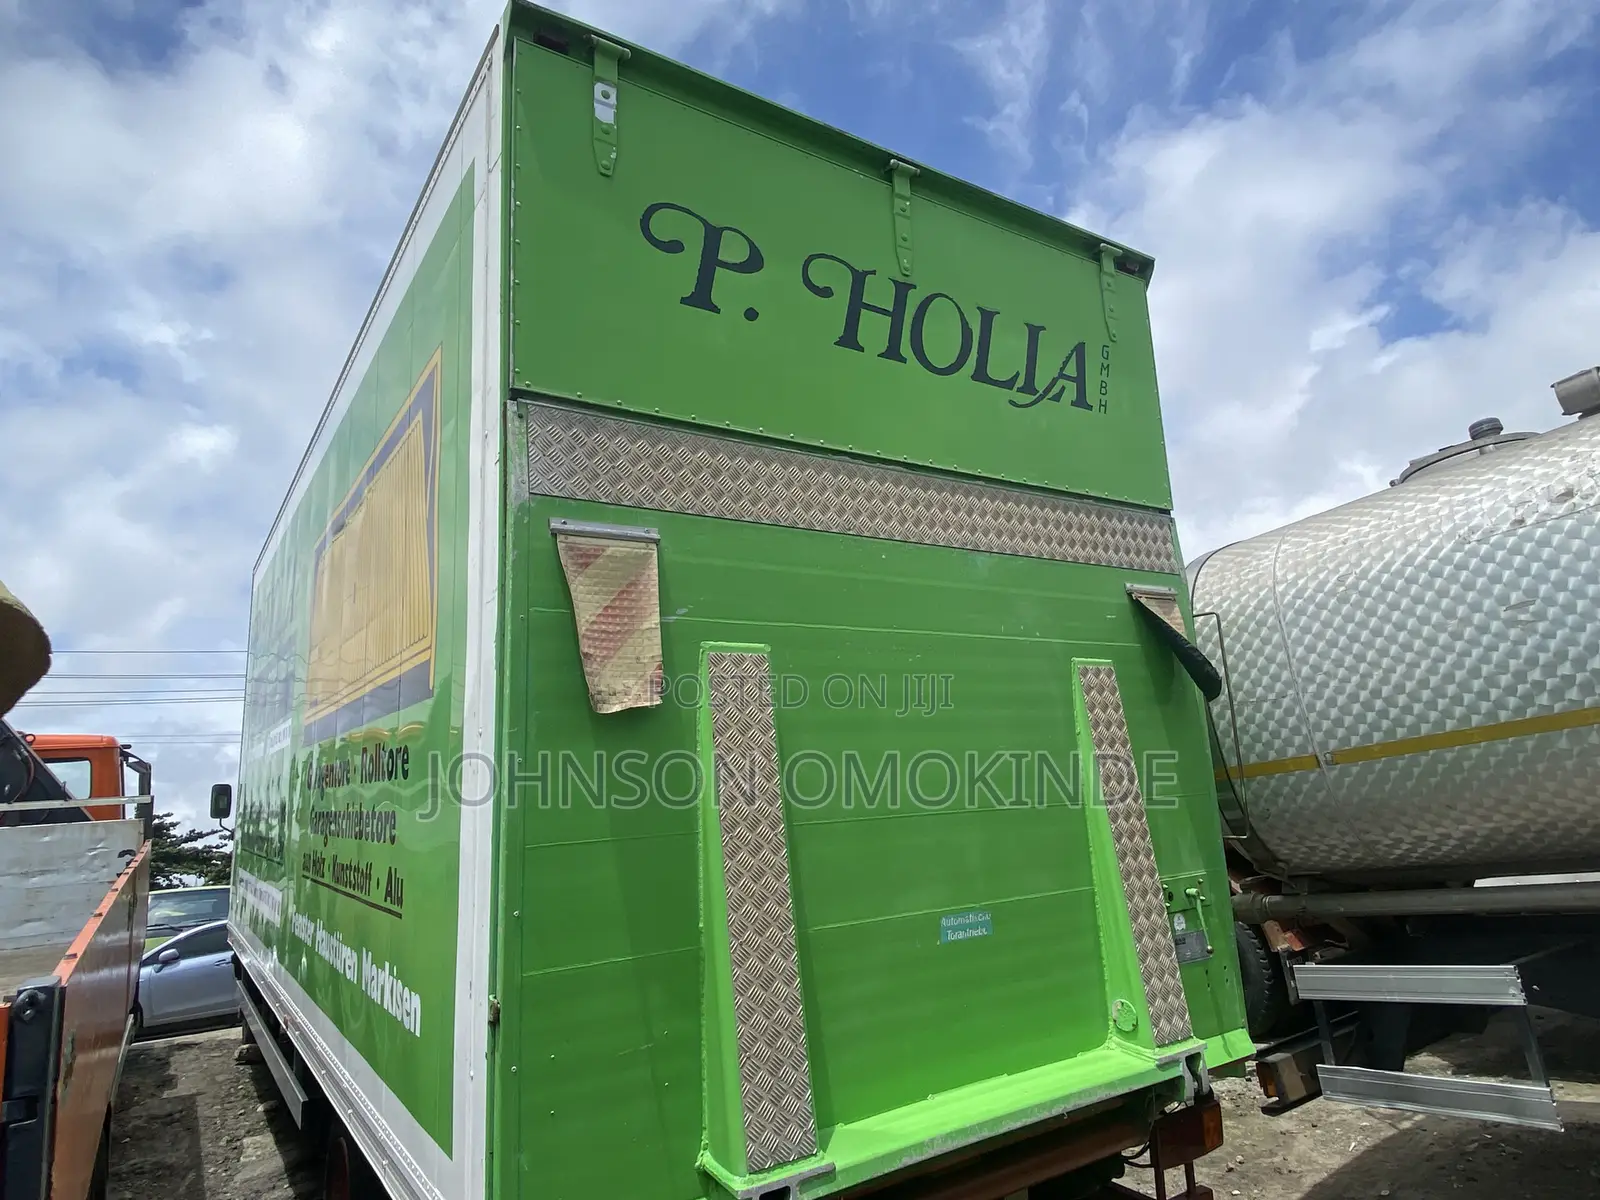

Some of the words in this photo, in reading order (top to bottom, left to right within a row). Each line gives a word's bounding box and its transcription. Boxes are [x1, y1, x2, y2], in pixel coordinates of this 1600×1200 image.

[639, 202, 764, 322] P.
[1098, 344, 1110, 415] GMBH
[360, 741, 410, 784] Rolltore
[312, 850, 326, 879] Holz
[331, 854, 373, 896] Kunststoff
[384, 866, 404, 909] Alu
[315, 918, 358, 985] Haustüren
[361, 947, 421, 1038] Markisen
